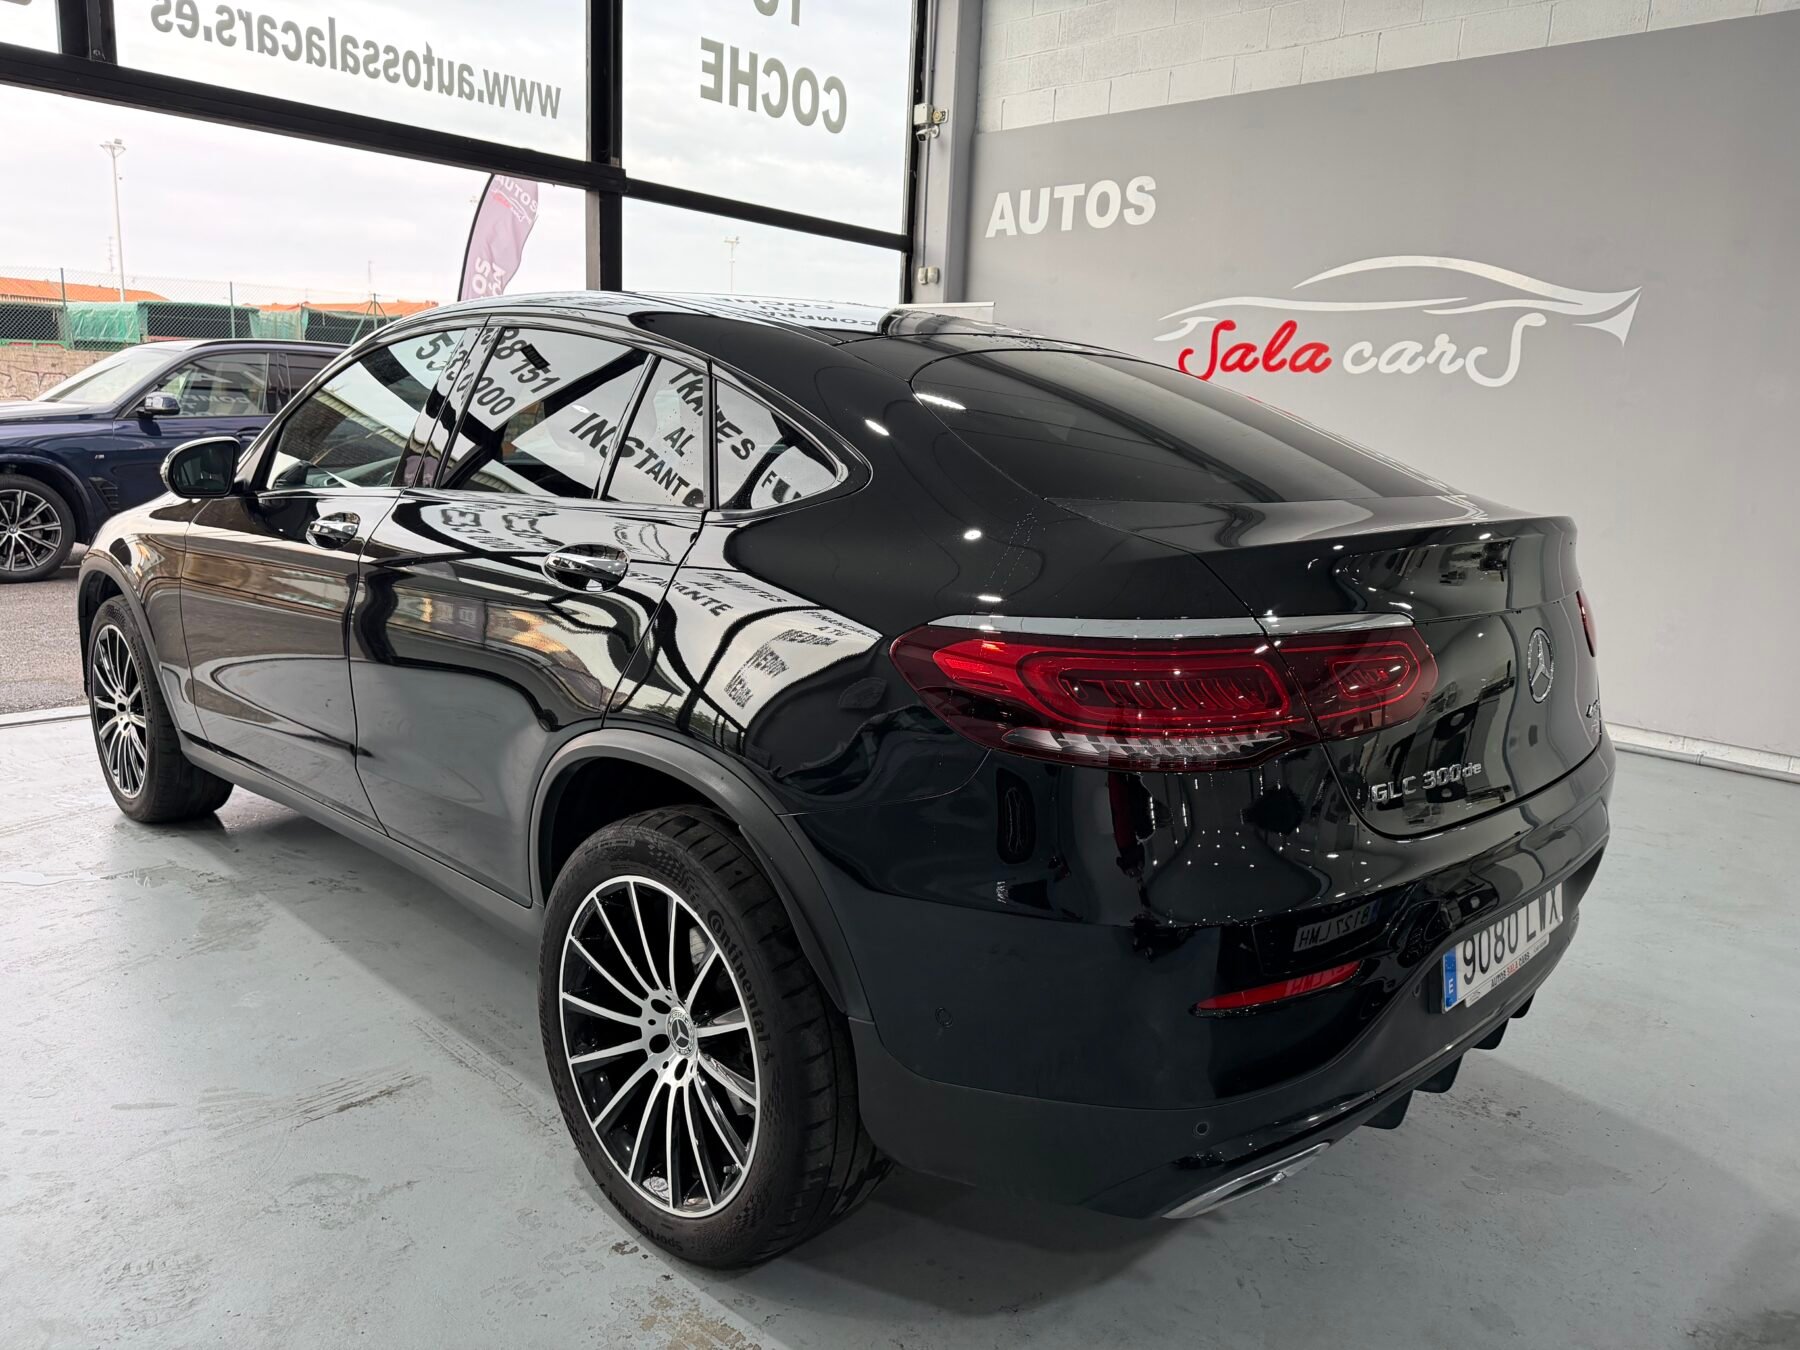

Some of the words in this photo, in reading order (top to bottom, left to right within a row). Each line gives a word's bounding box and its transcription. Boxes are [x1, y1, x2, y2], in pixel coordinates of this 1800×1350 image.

[985, 175, 1157, 239] AUTOS
[1178, 319, 1333, 382] Sala
[663, 427, 695, 458] AL
[1371, 775, 1417, 802] GLC
[1422, 762, 1482, 790] 300de
[707, 909, 771, 1042] Continental
[1463, 911, 1519, 986] 9080
[1448, 978, 1454, 994] E
